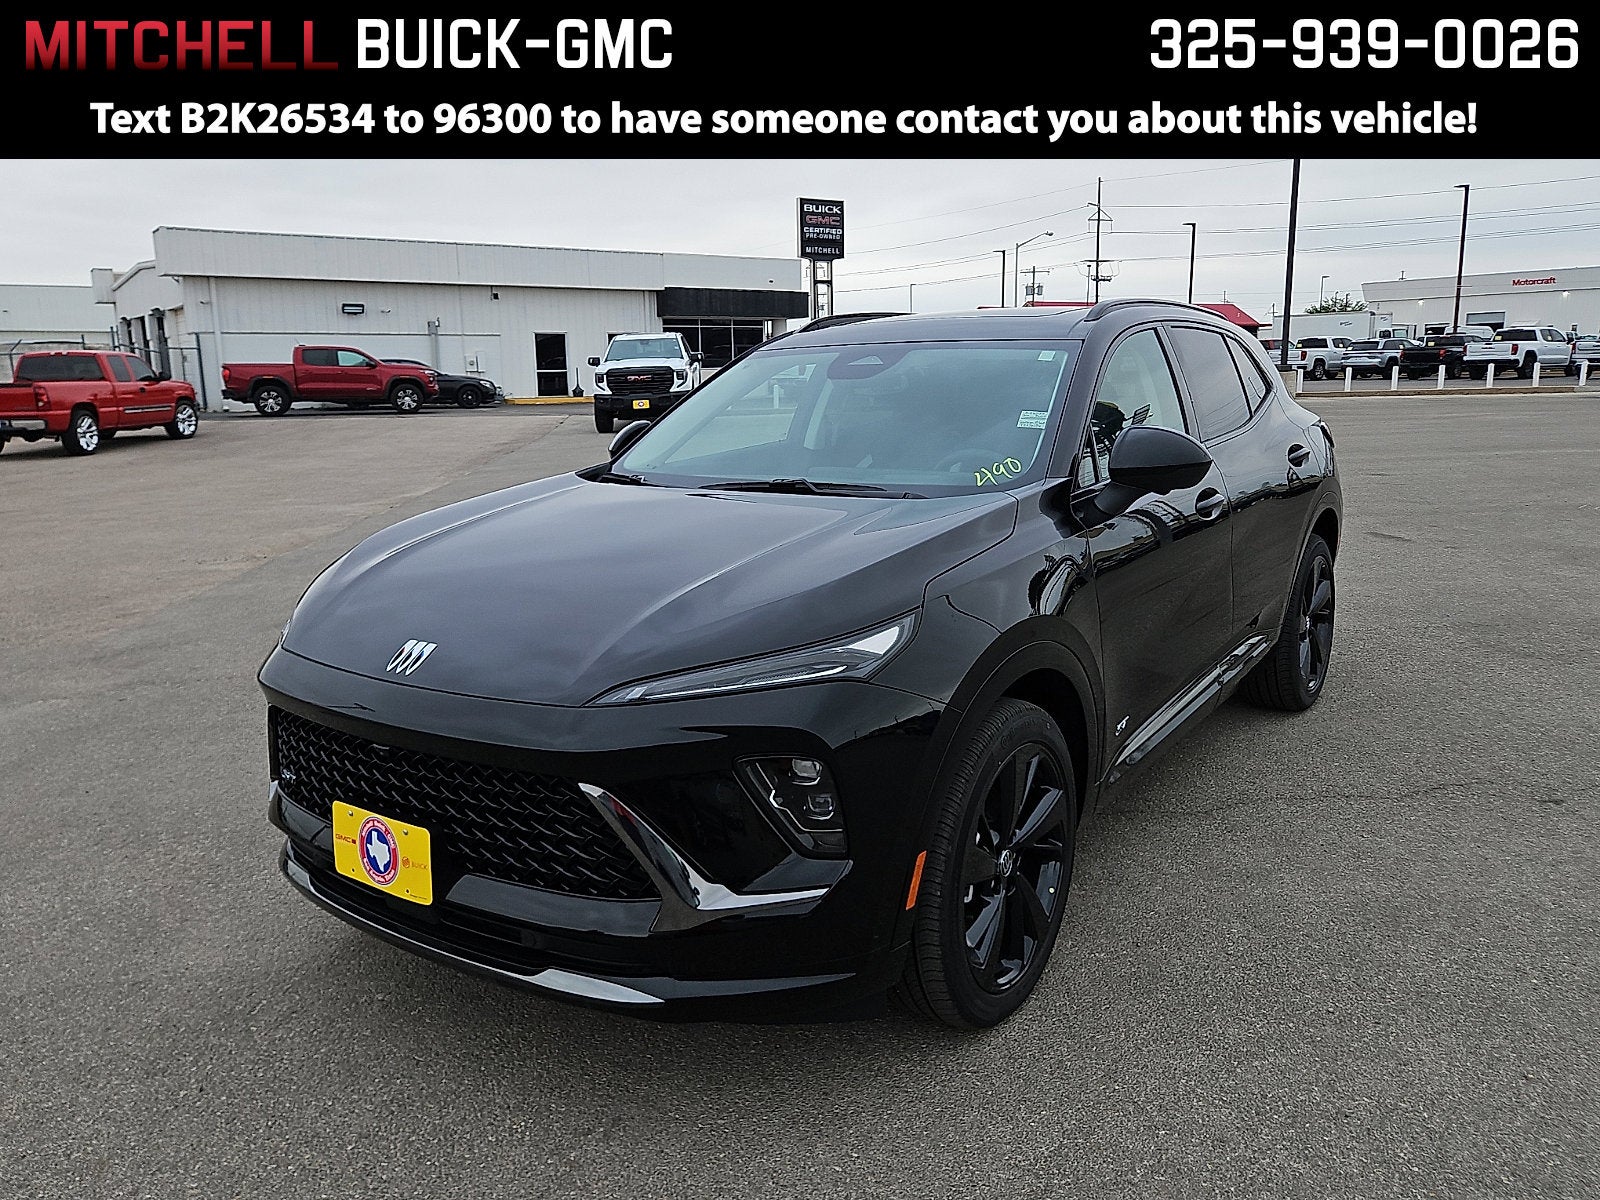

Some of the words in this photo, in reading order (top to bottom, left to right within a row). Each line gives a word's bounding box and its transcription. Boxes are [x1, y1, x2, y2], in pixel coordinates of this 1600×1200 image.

[804, 204, 842, 213] BUICK
[806, 215, 840, 225] GMC
[1512, 276, 1556, 286] Motorcraft
[974, 457, 1023, 487] 490
